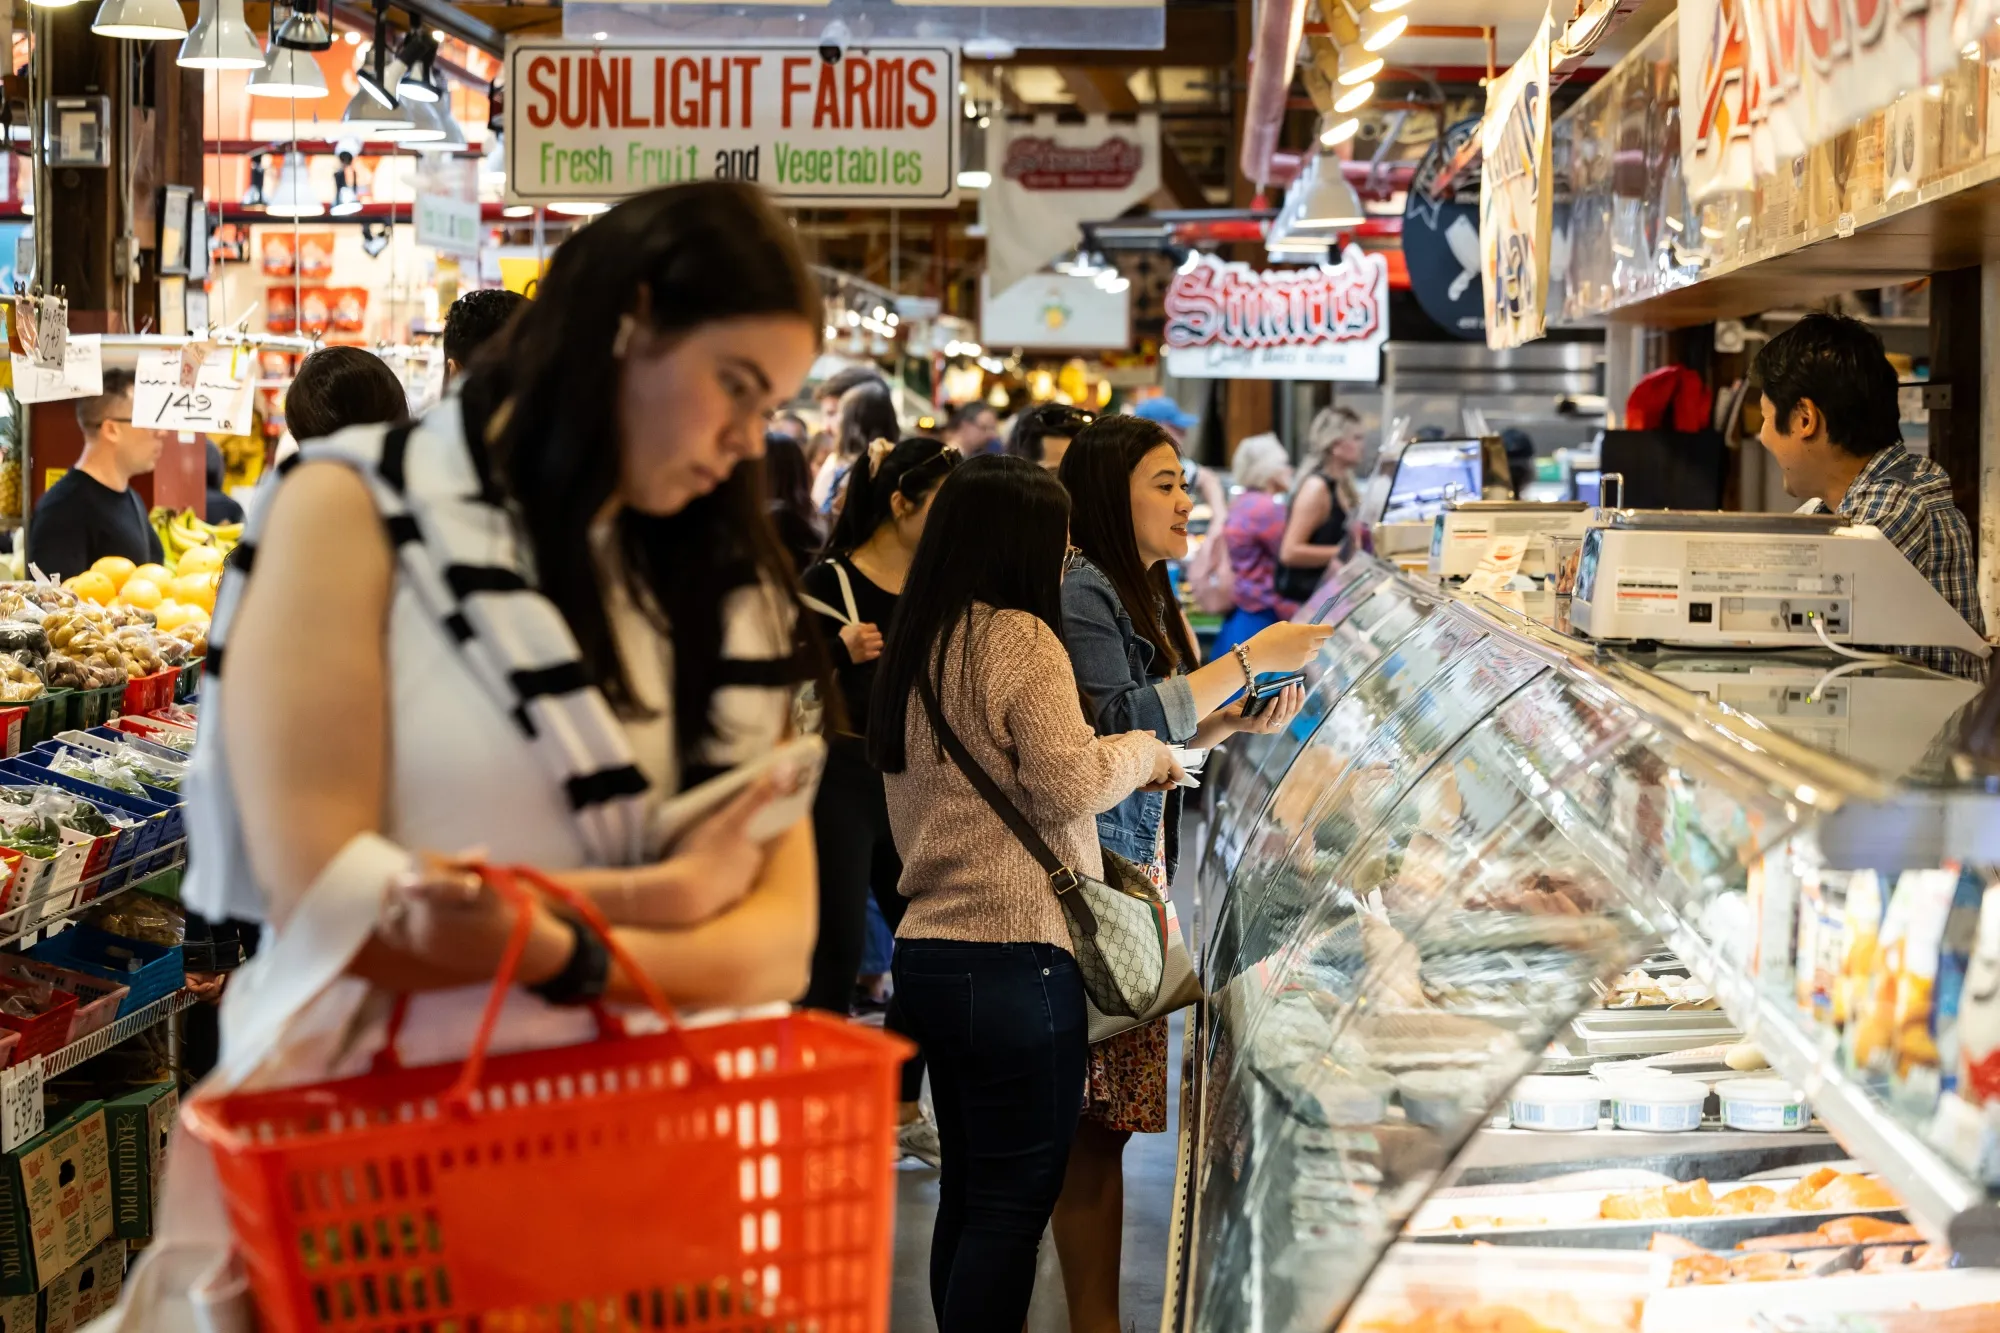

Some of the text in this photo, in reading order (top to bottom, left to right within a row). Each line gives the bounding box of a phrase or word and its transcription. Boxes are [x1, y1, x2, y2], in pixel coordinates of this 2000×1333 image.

[528, 55, 938, 131] SUNLIGHT FARMS
[541, 141, 922, 186] Fresh Fruit and Vegetables
[118, 1126, 138, 1193] EXCELLENT
[120, 1195, 138, 1224] PICK
[1, 1248, 21, 1279] PICK
